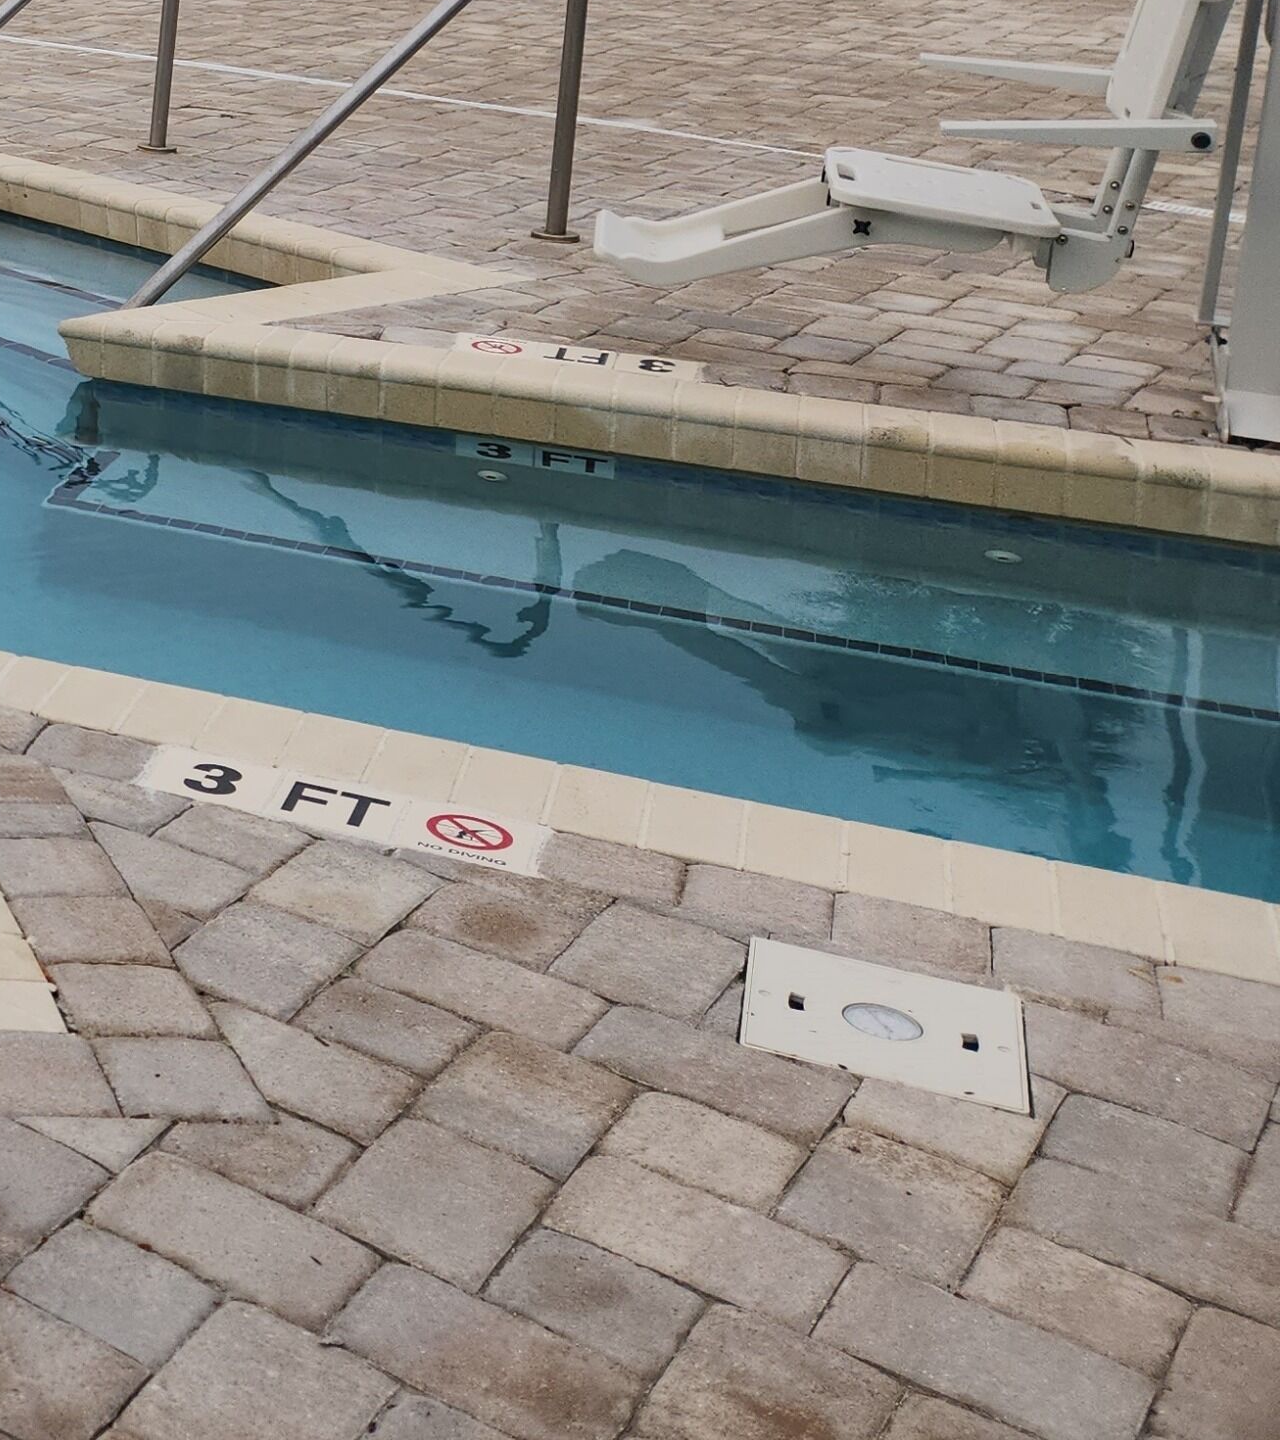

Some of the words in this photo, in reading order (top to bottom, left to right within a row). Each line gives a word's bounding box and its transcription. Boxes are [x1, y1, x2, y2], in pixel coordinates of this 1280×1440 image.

[543, 347, 610, 366] FT
[638, 358, 676, 373] 3
[476, 441, 512, 460] 3
[541, 450, 608, 474] FT
[183, 763, 243, 796] 3
[280, 781, 391, 828] FT
[417, 841, 443, 851] NO
[448, 848, 507, 866] DIVING
